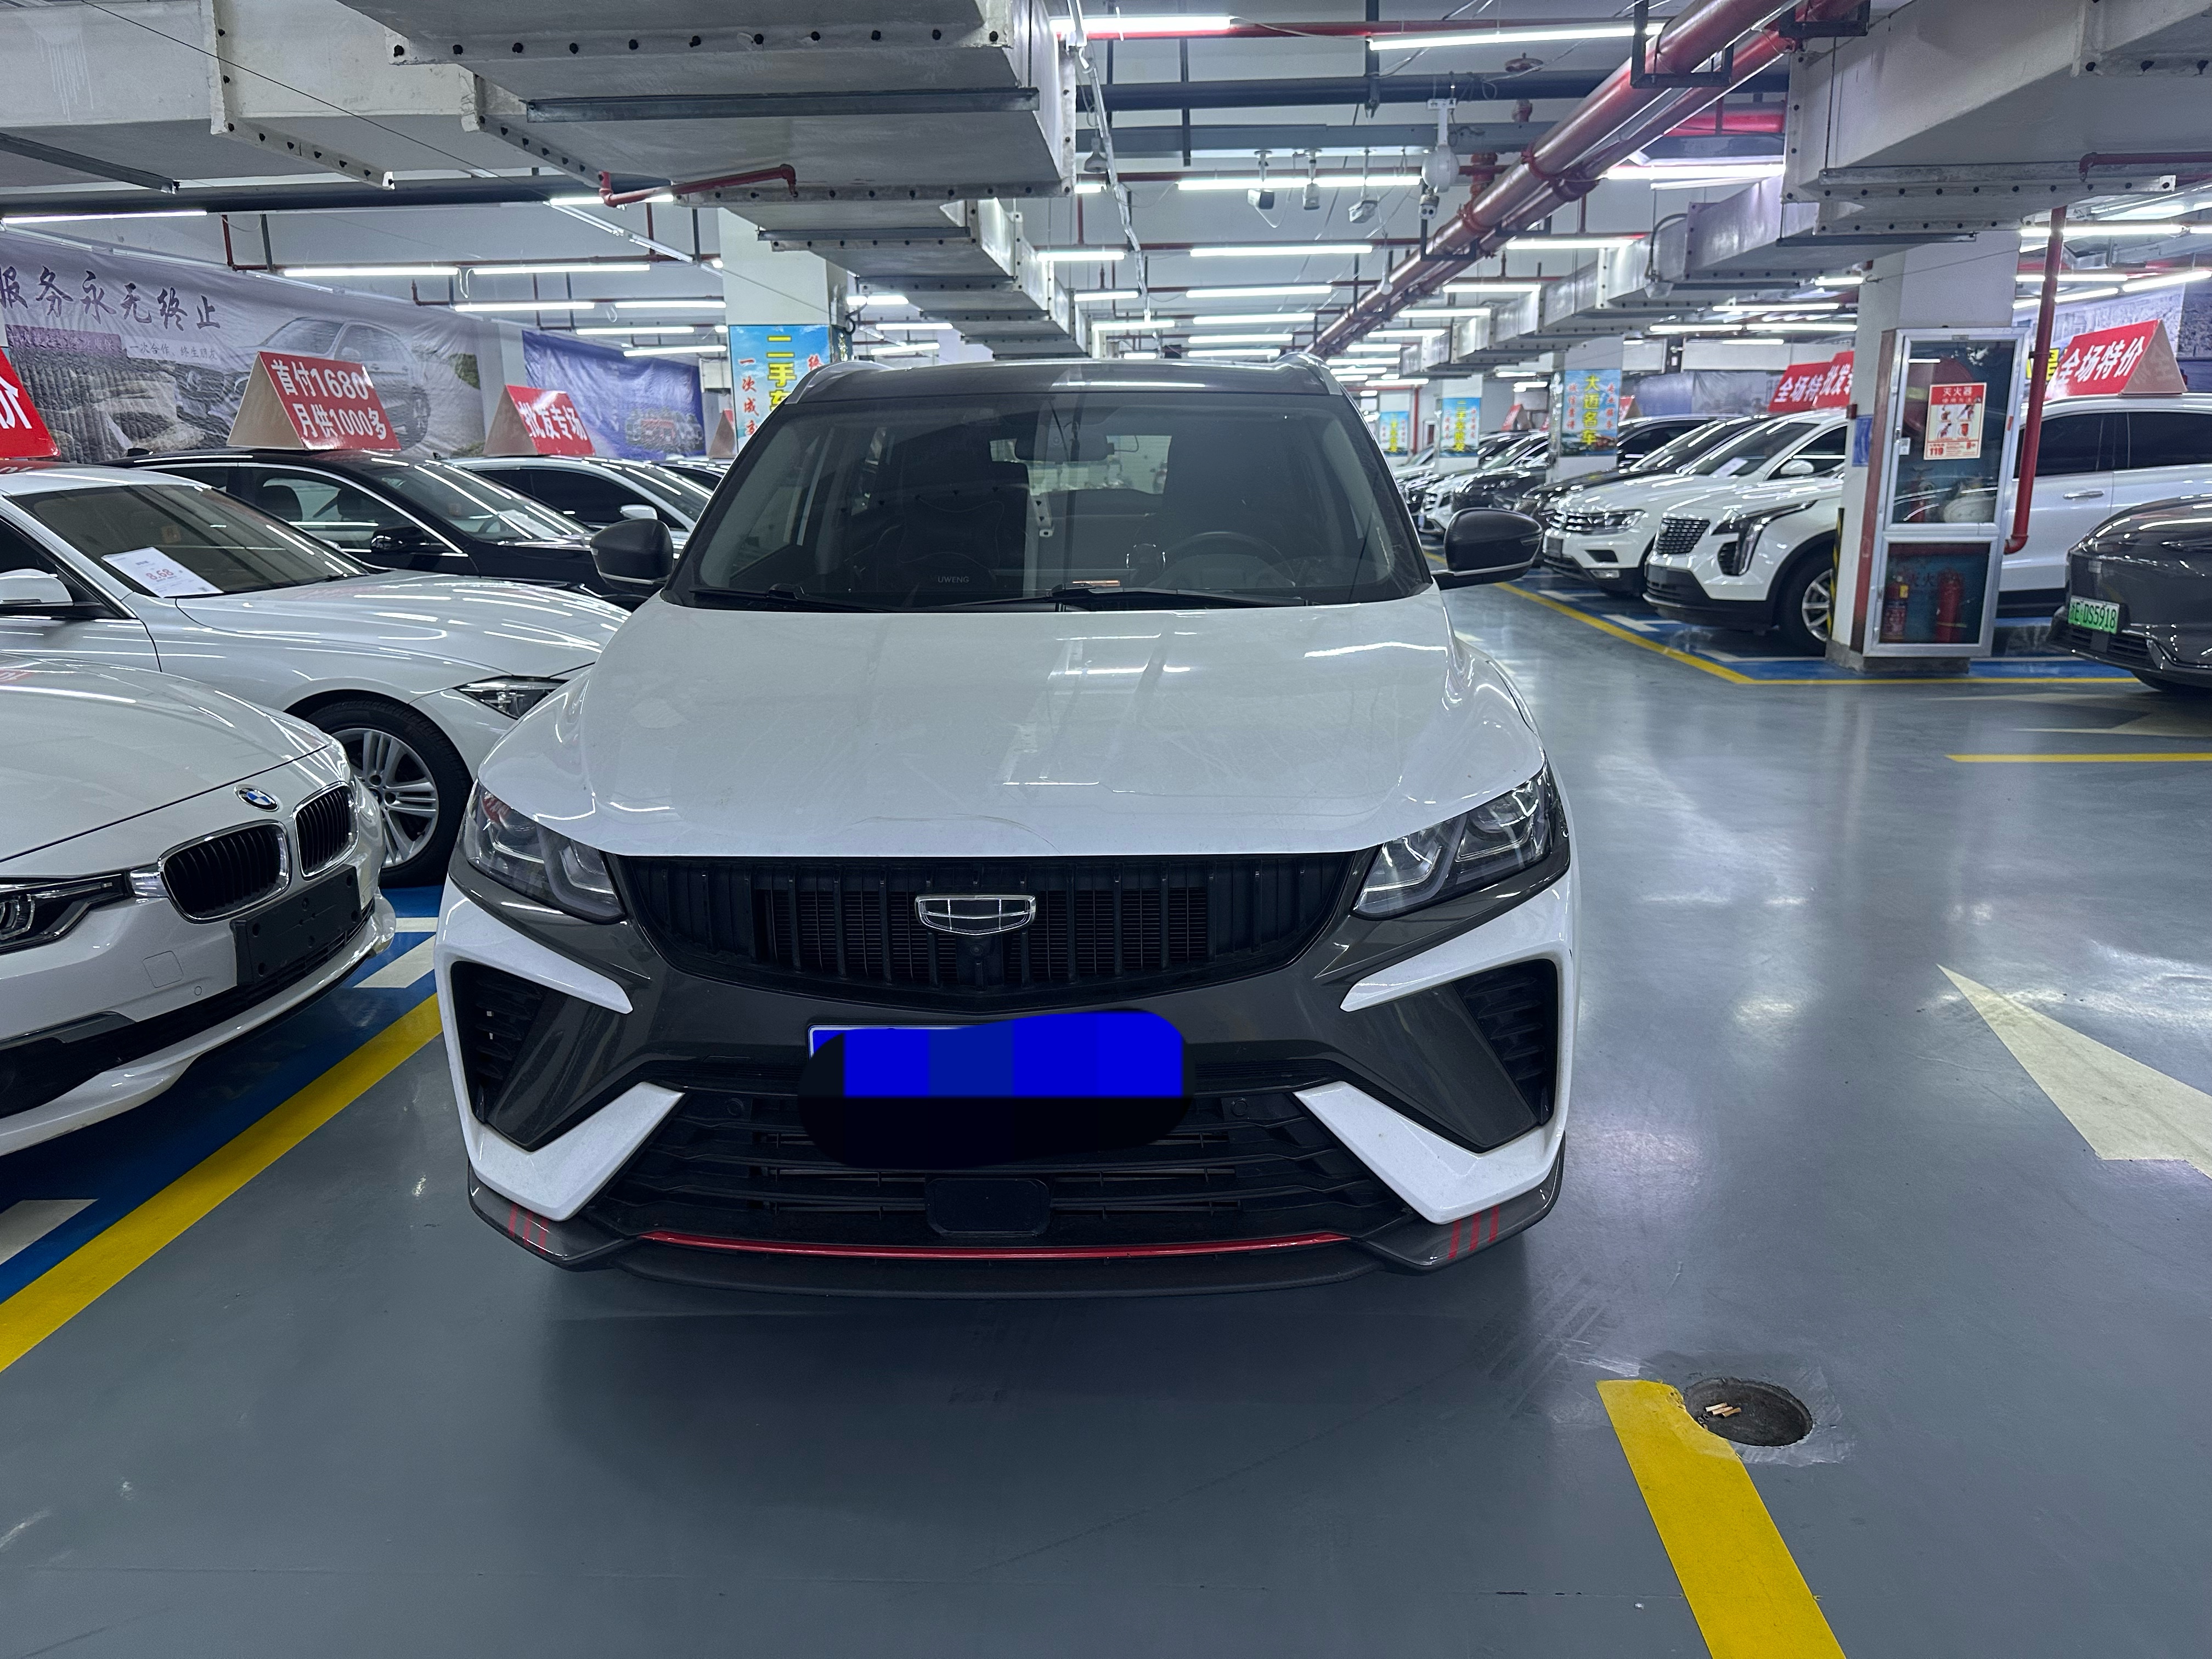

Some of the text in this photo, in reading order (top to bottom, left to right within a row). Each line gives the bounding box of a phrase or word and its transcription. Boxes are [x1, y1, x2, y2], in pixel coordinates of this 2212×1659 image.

[2058, 336, 2145, 384] 全场特价
[1943, 386, 1972, 396] 灭火器
[292, 403, 387, 440] 月供1000多
[518, 400, 588, 441] 批发专场
[145, 568, 174, 580] 8.68
